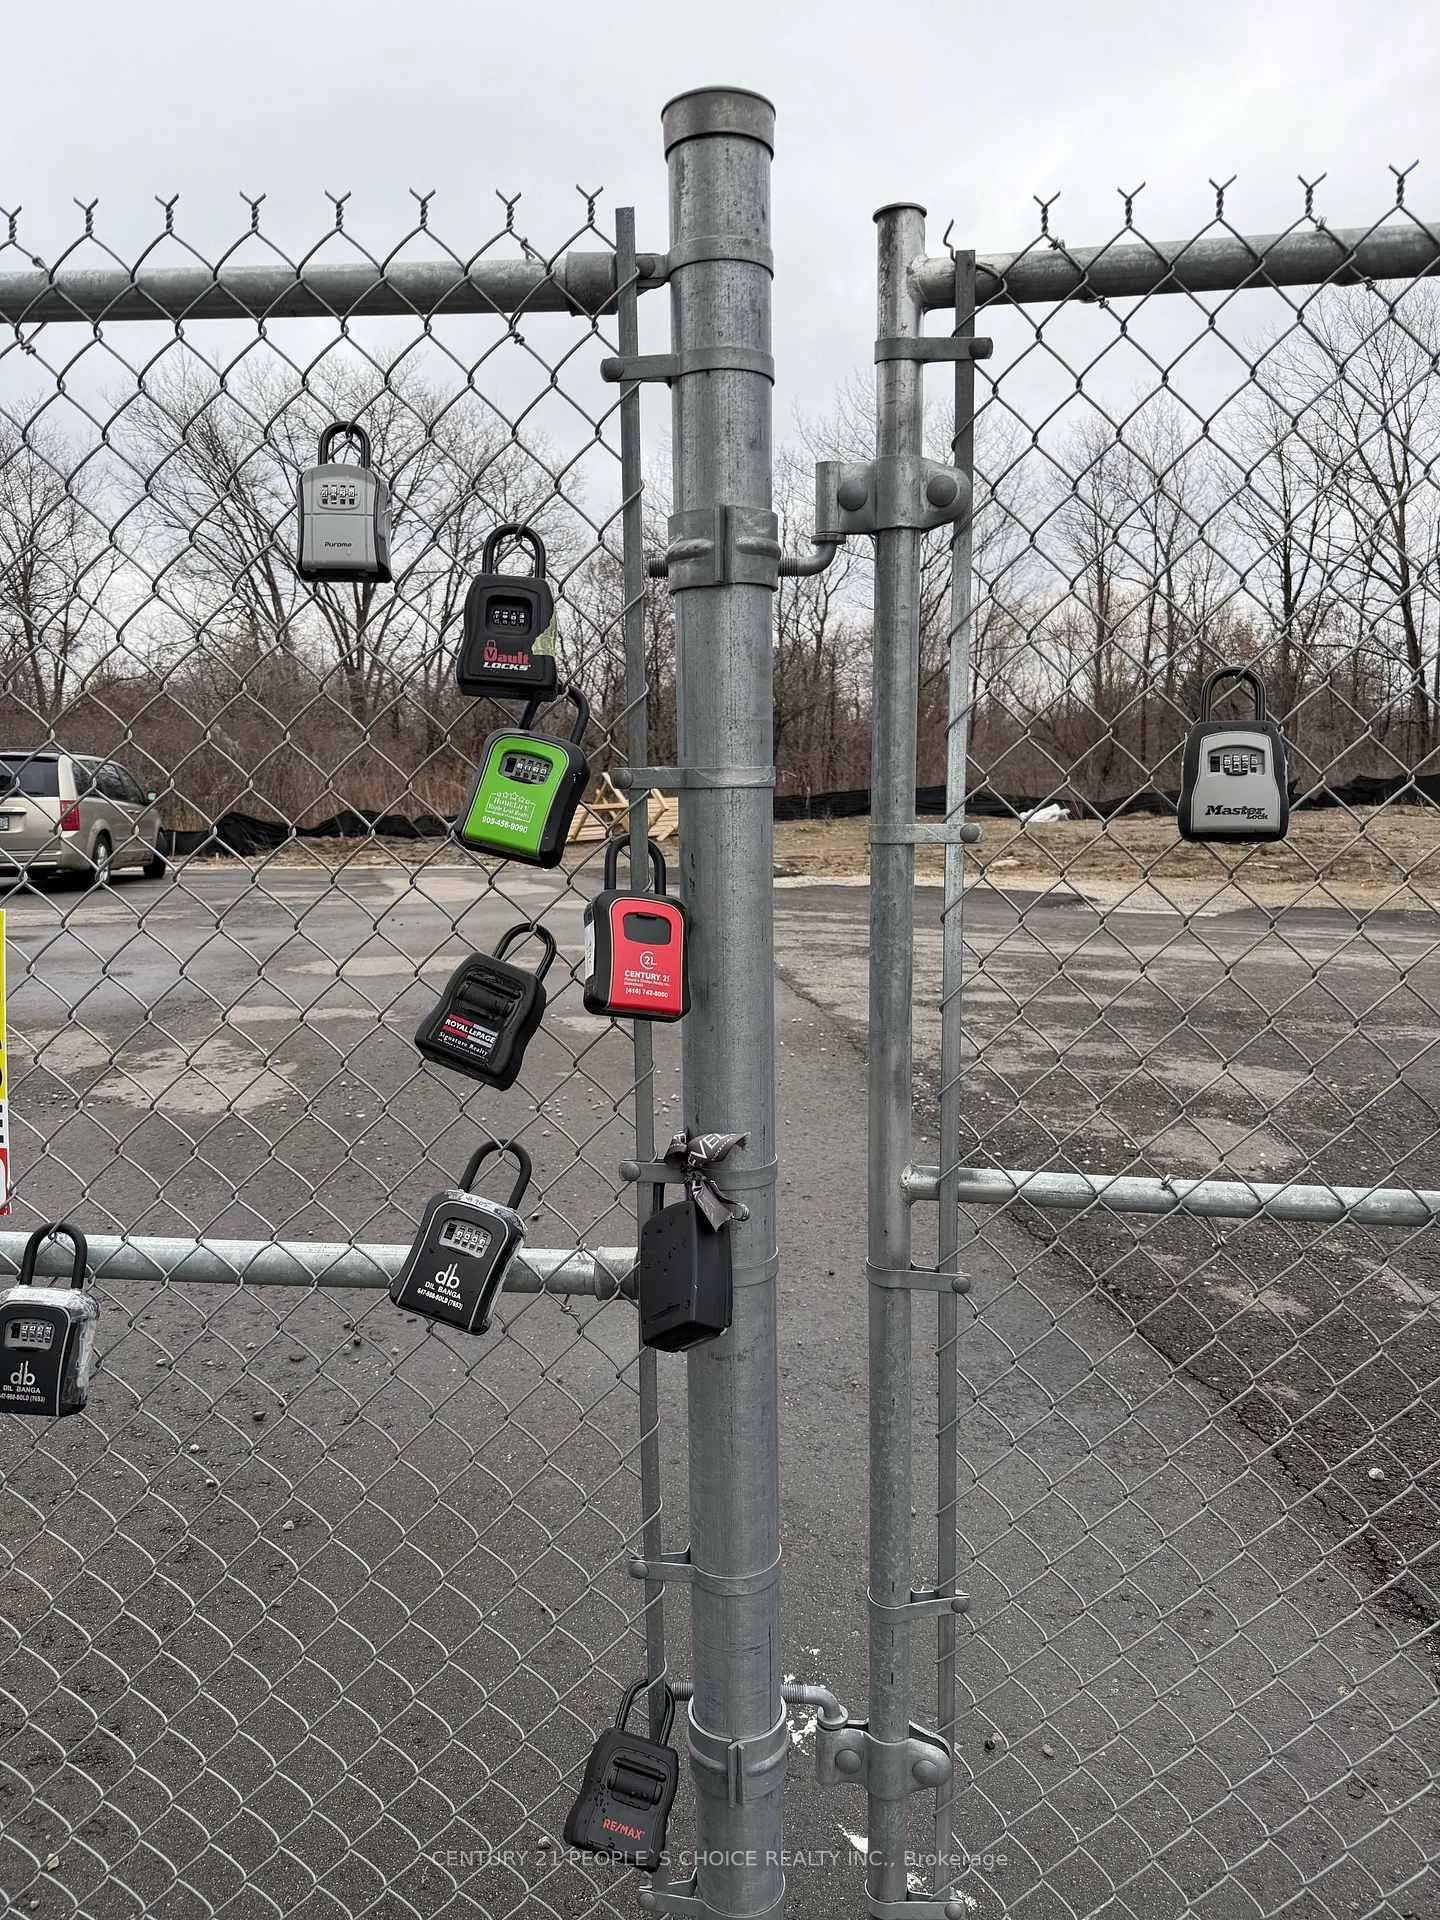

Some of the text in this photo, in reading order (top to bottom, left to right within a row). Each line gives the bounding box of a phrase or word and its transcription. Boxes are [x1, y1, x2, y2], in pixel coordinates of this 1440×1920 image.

[483, 646, 529, 665] Vault
[483, 661, 530, 671] LOCKS
[1205, 805, 1266, 816] Master
[624, 970, 662, 981] CENTURY
[445, 1018, 470, 1034] ROYAL
[439, 1031, 468, 1047] Signature
[470, 1043, 488, 1057] Realty
[434, 1263, 460, 1289] db
[424, 1281, 461, 1300] DIL BANGA
[10, 1360, 36, 1386] db
[2, 1384, 41, 1394] DIL BANGA
[602, 1818, 643, 1841] RE/MAX
